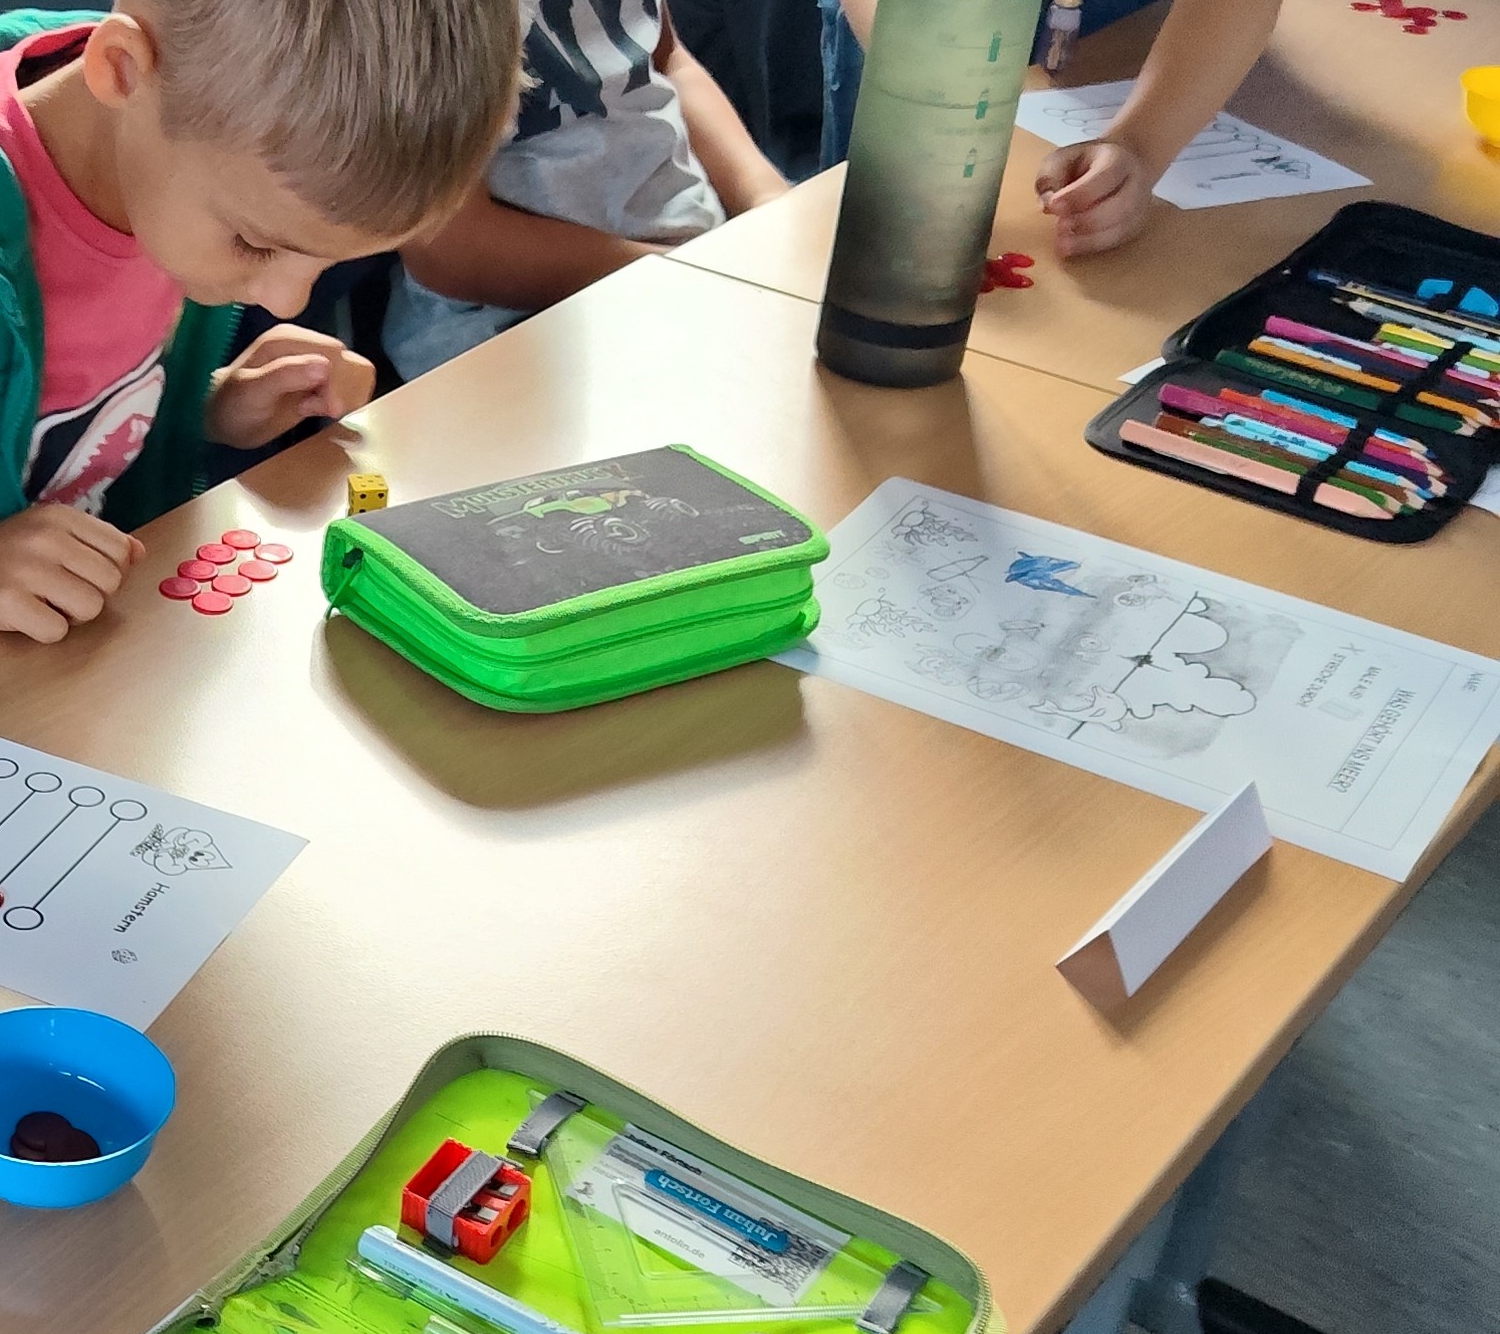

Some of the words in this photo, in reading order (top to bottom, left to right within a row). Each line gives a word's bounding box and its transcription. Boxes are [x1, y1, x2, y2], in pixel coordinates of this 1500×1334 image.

[1388, 689, 1417, 710] WAS
[112, 881, 170, 934] Hamstern
[722, 1203, 779, 1243] Julian
[652, 1227, 706, 1260] antolin.de
